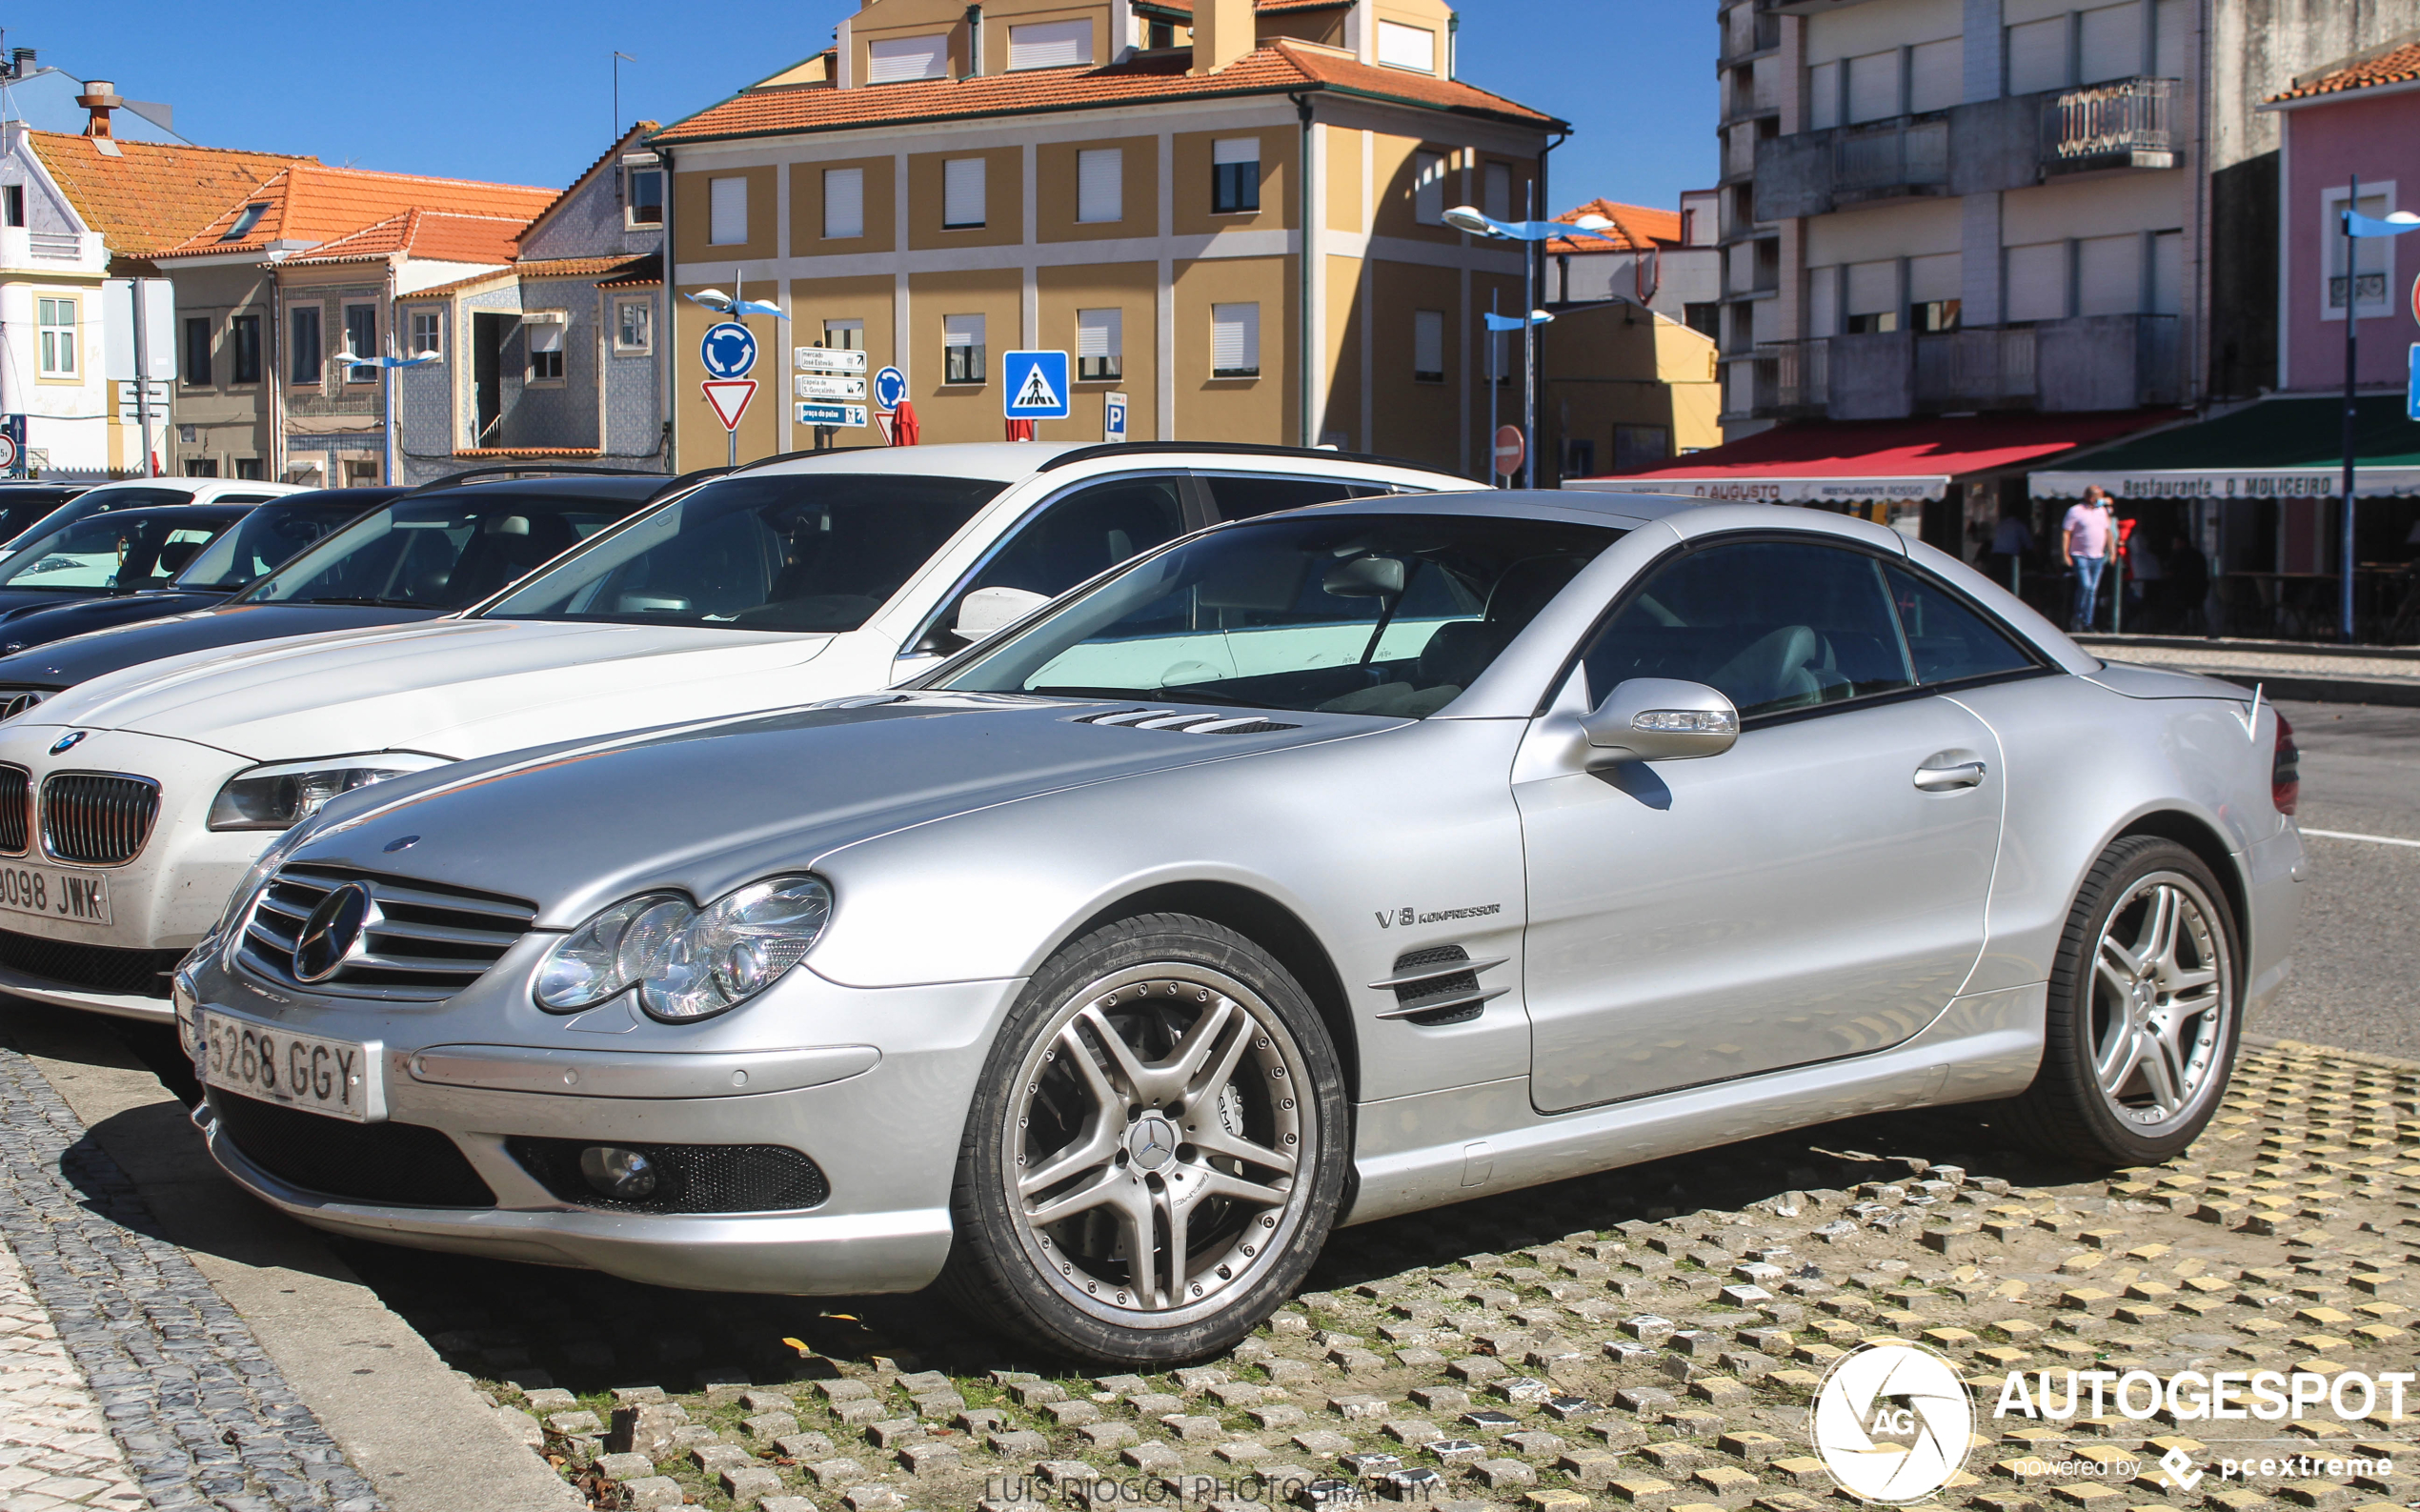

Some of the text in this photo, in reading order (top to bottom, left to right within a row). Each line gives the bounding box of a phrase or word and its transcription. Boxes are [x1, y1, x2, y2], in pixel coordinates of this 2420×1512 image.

[803, 410, 817, 418] praça
[1109, 407, 1122, 430] P
[1822, 486, 1885, 496] RESTAURANTE
[2123, 476, 2331, 496] Restaurante O MOLICEIRO
[57, 876, 103, 919] JWK
[1419, 903, 1501, 924] KOMPRESSOR
[210, 1018, 354, 1106] 5268 GGY
